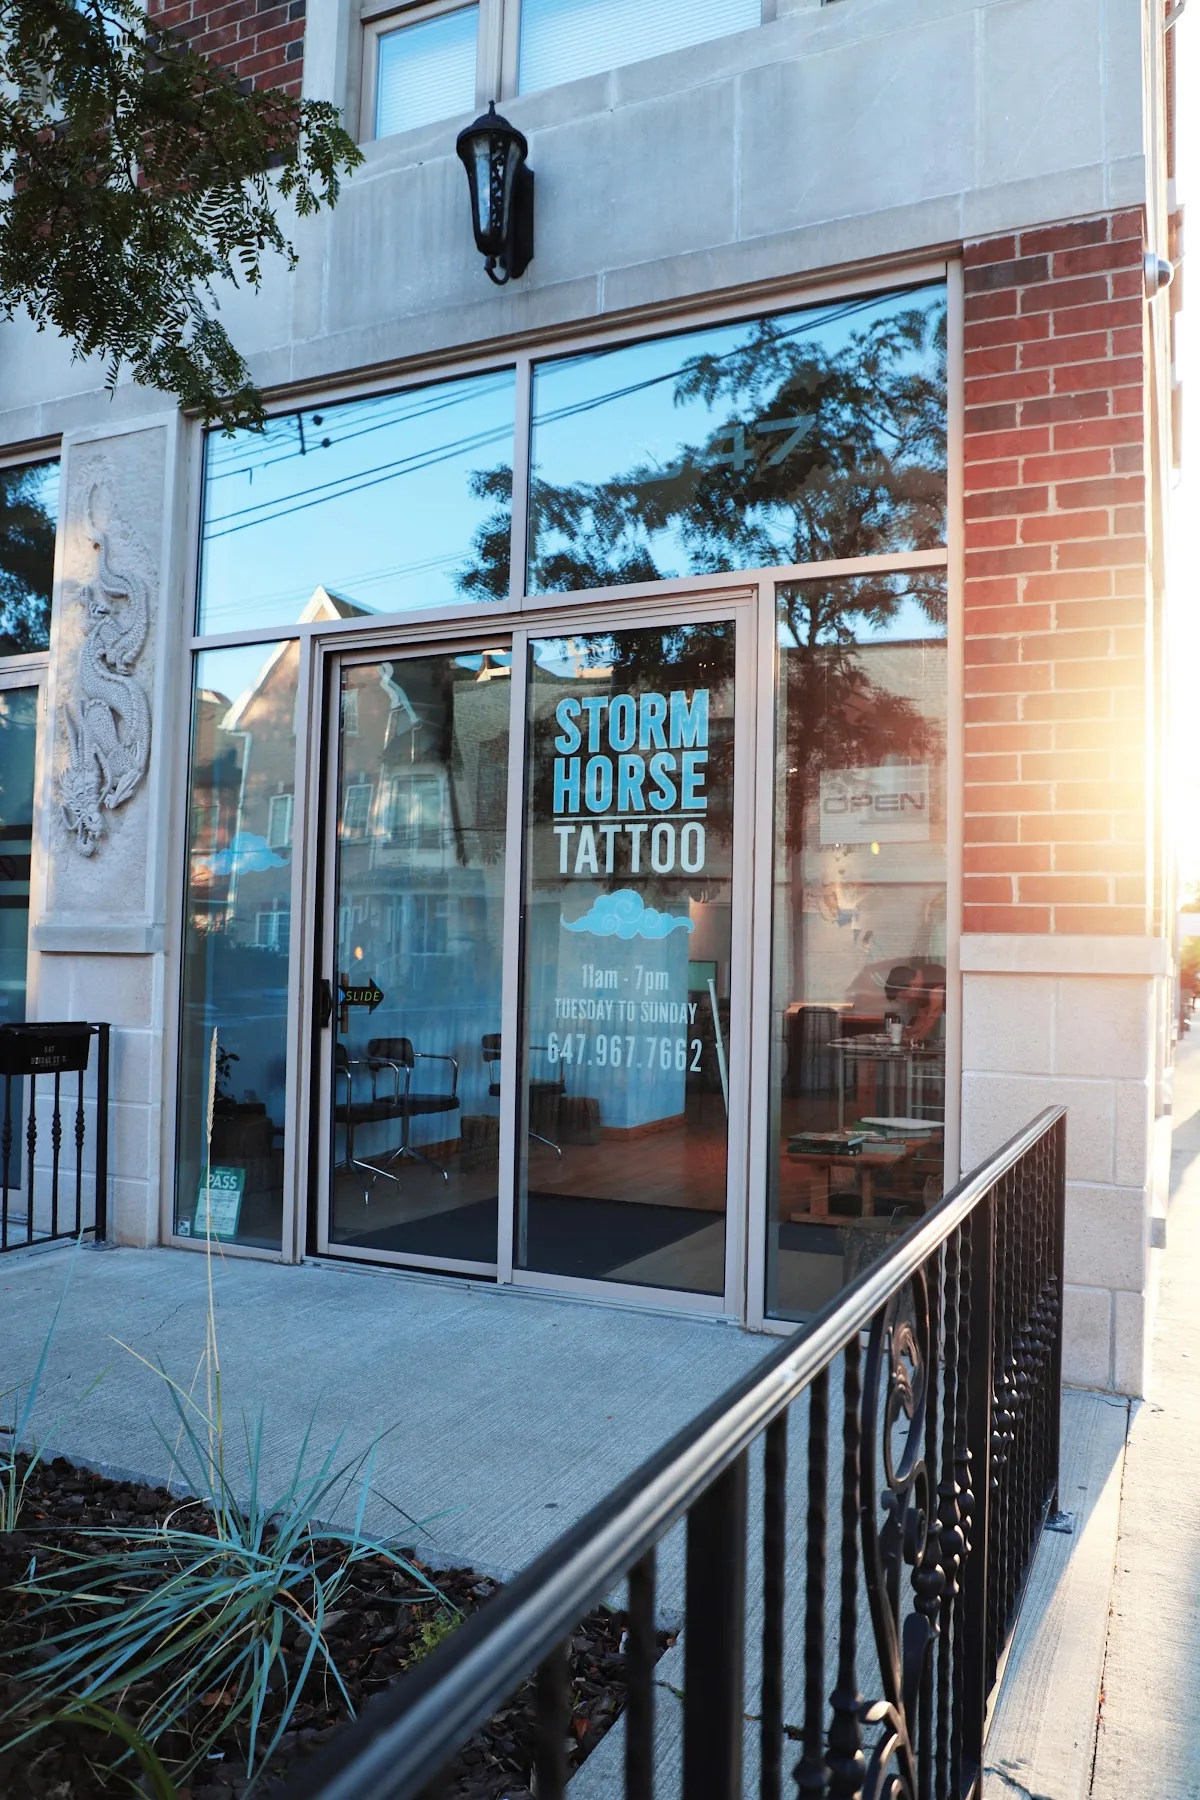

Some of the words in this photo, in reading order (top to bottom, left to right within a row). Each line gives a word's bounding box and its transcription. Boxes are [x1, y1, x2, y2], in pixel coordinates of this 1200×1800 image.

[554, 688, 710, 755] STORM
[553, 750, 709, 814] HORSE
[823, 792, 926, 814] OPEN
[553, 821, 706, 874] TATTOO
[346, 990, 381, 1002] SLIDE
[582, 963, 618, 990] 11am
[634, 965, 670, 996] 7pm
[554, 998, 614, 1021] TUESDAY
[618, 1000, 636, 1022] TO
[640, 1001, 698, 1025] SUNDAY
[547, 1031, 703, 1073] 647.967.7662
[206, 1173, 238, 1190] PASS
